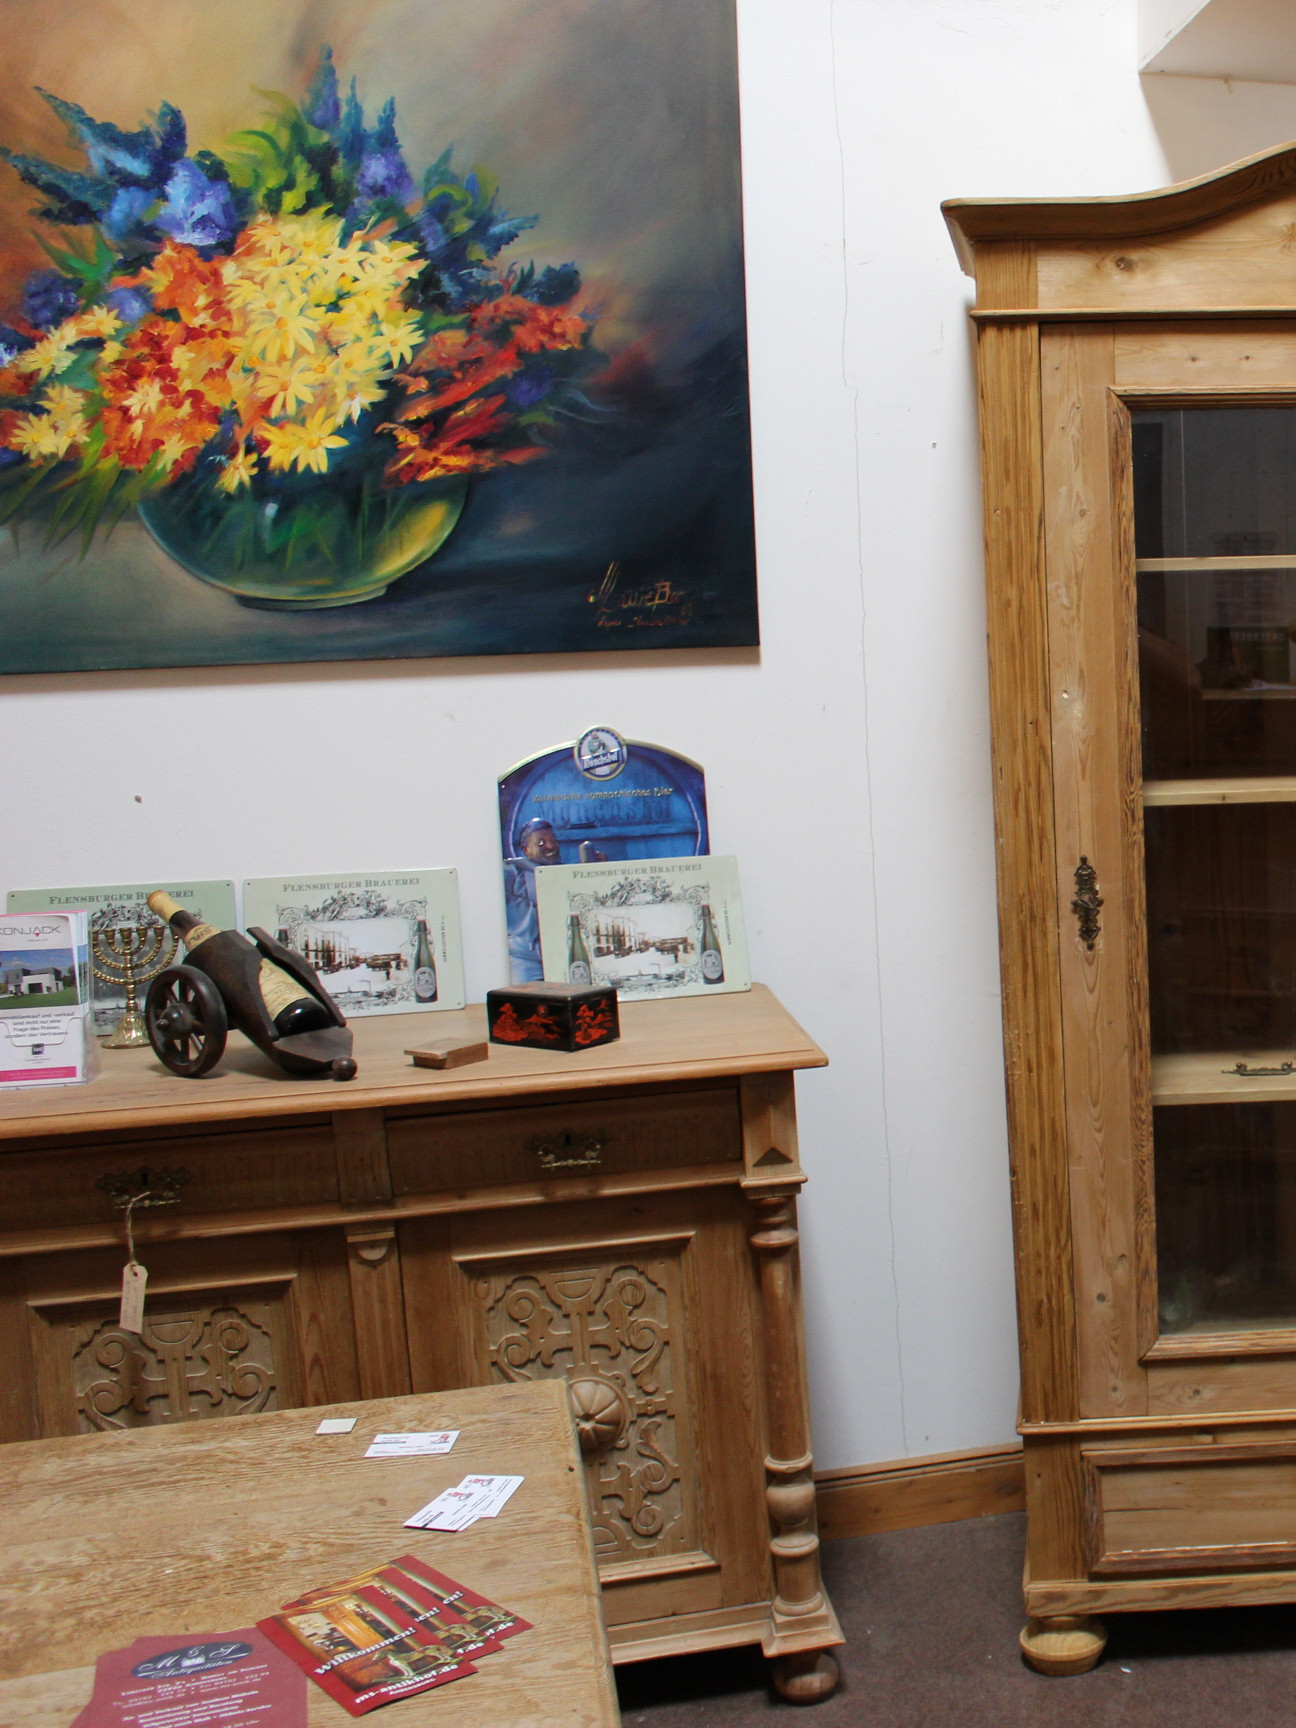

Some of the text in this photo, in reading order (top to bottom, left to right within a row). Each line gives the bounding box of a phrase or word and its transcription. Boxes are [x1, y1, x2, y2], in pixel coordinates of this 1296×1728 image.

[573, 863, 702, 879] FLENSBURGER BRAUEREI
[283, 877, 420, 892] FLENSBURGER BRAUEREI
[49, 893, 133, 905] FLENSBURGER
[314, 1626, 416, 1674] Willkommen!
[355, 1664, 458, 1703] ms-antikhof.de
